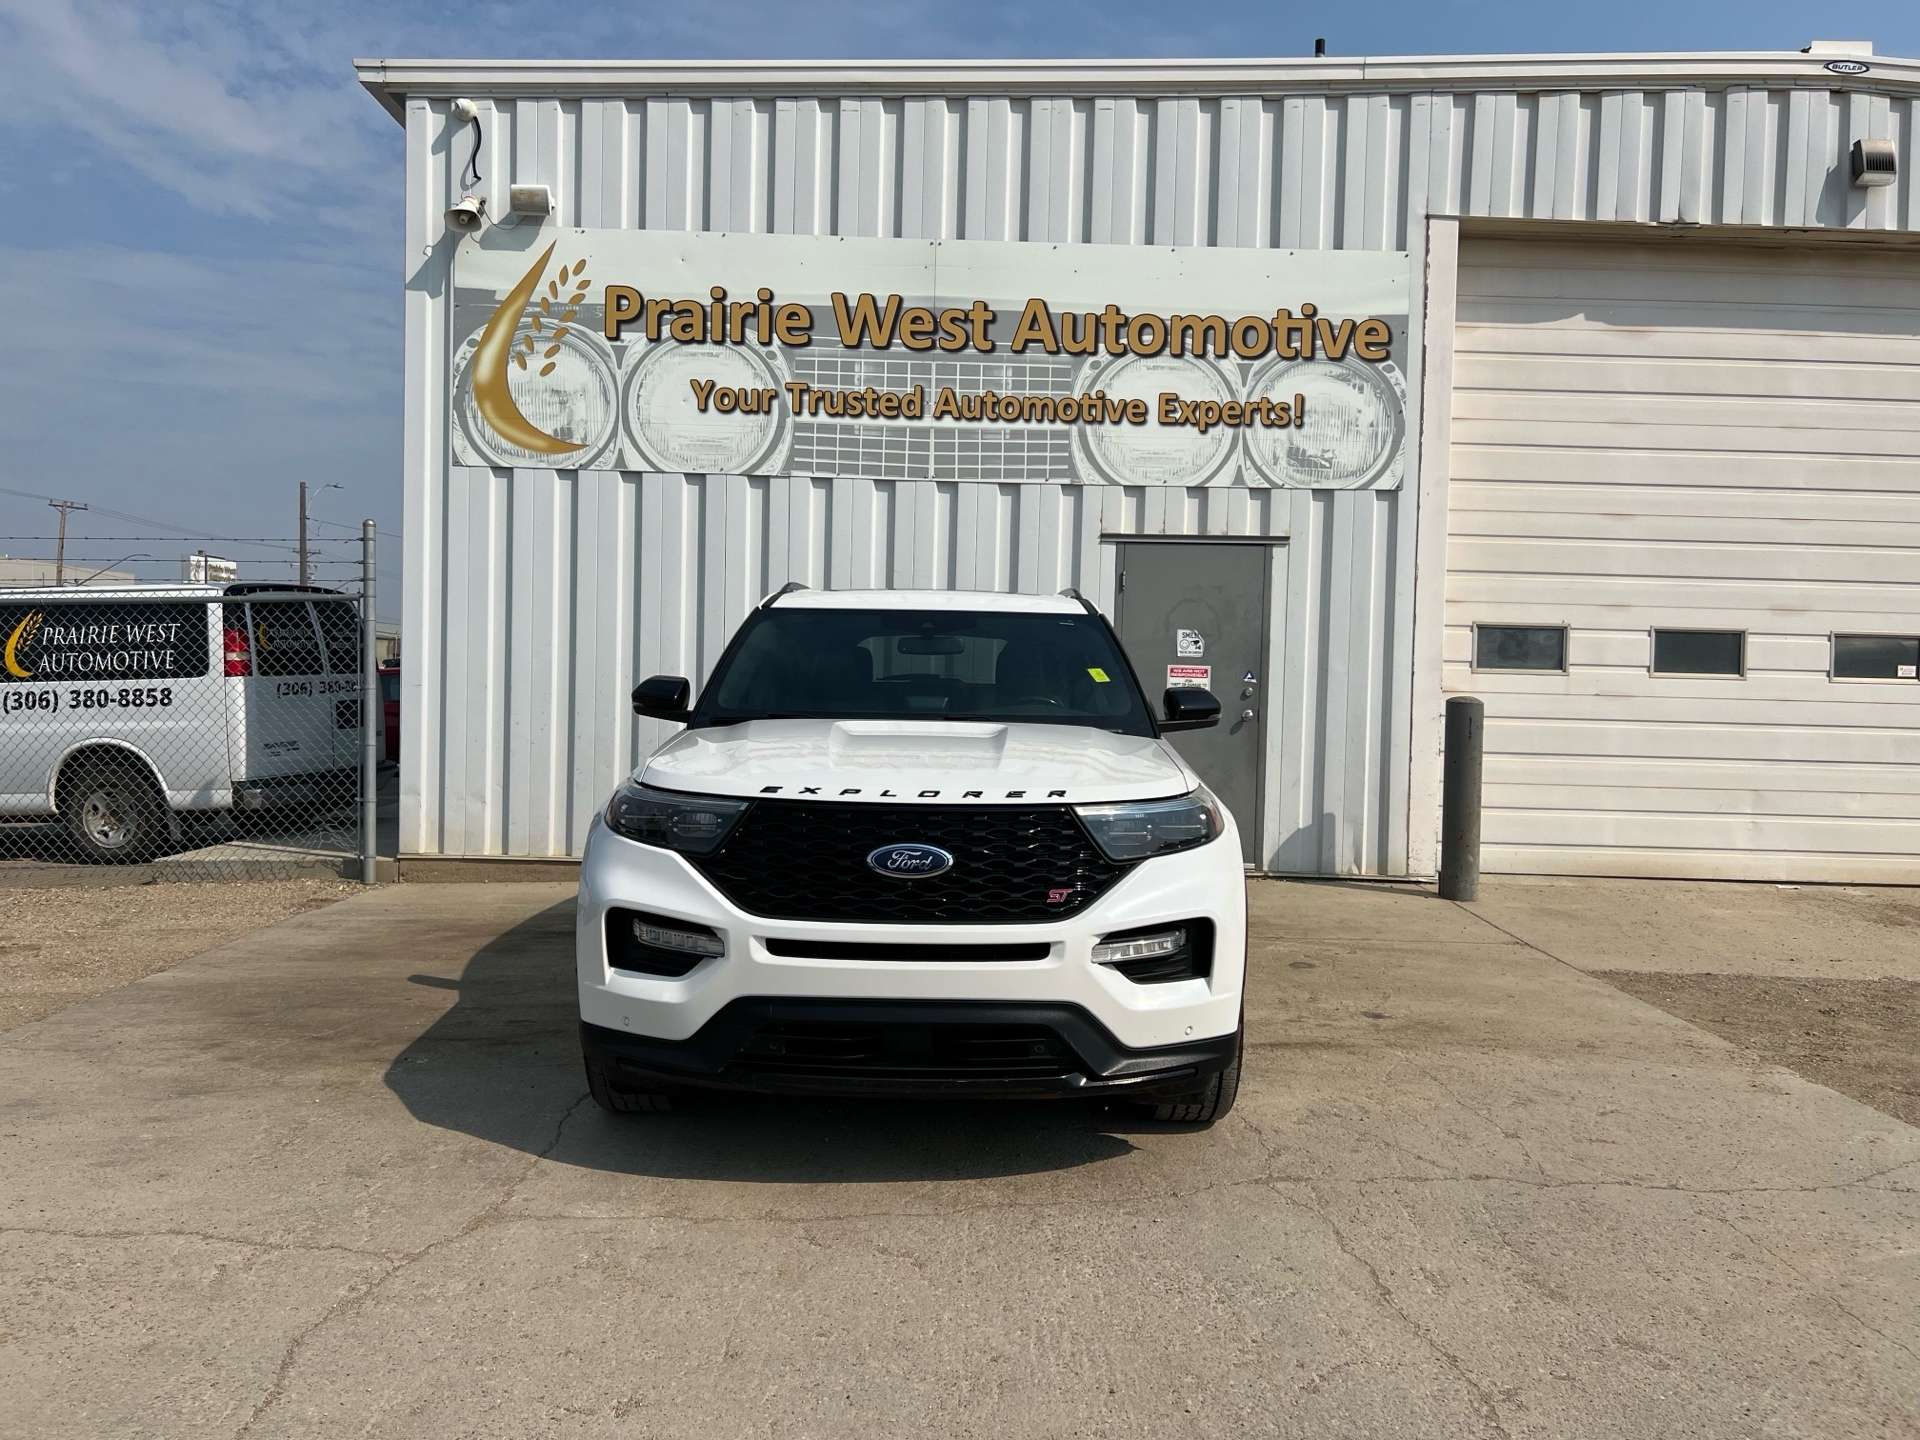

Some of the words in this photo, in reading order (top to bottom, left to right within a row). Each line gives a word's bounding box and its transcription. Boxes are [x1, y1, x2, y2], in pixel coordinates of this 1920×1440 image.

[604, 285, 813, 345] Prairie
[832, 292, 994, 352] West
[1010, 298, 1391, 361] Automotive
[690, 378, 776, 414] Your
[784, 382, 923, 418] Trusted
[933, 387, 1147, 425] Automotive
[1157, 392, 1306, 433] Experts!
[42, 625, 119, 645] PRAIRIE
[127, 624, 181, 642] WEST
[38, 650, 175, 673] AUTOMOTIVE
[2, 689, 59, 714] (306)
[69, 688, 172, 709] 380-8858
[760, 786, 1068, 799] EXPLORER
[887, 850, 934, 871] Ford
[1046, 888, 1073, 903] ST
